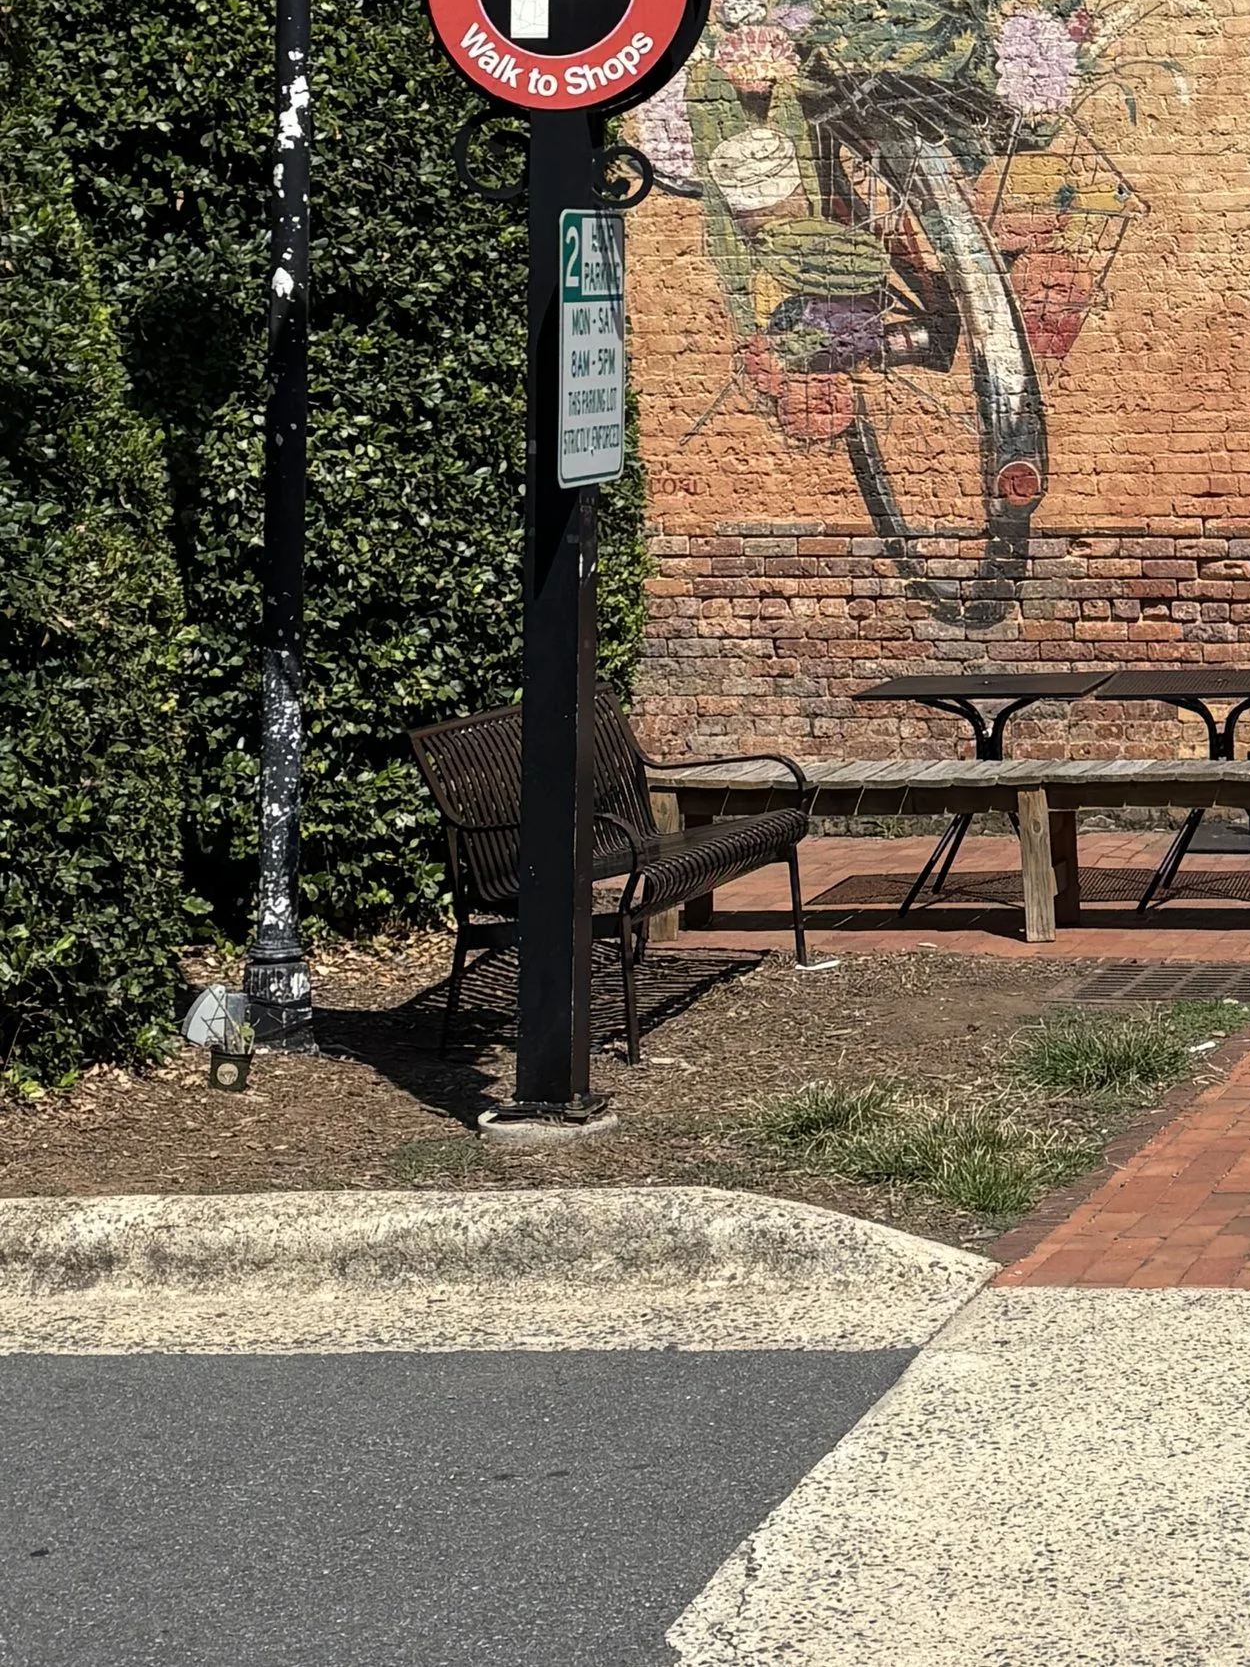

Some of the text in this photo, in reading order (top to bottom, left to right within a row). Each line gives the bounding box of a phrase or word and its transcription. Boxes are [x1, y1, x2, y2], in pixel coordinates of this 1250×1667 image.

[460, 22, 654, 97] Walk to Shops
[565, 226, 580, 287] 2
[572, 308, 591, 336] MON
[571, 350, 590, 378] 8AM
[598, 348, 615, 376] 5PM
